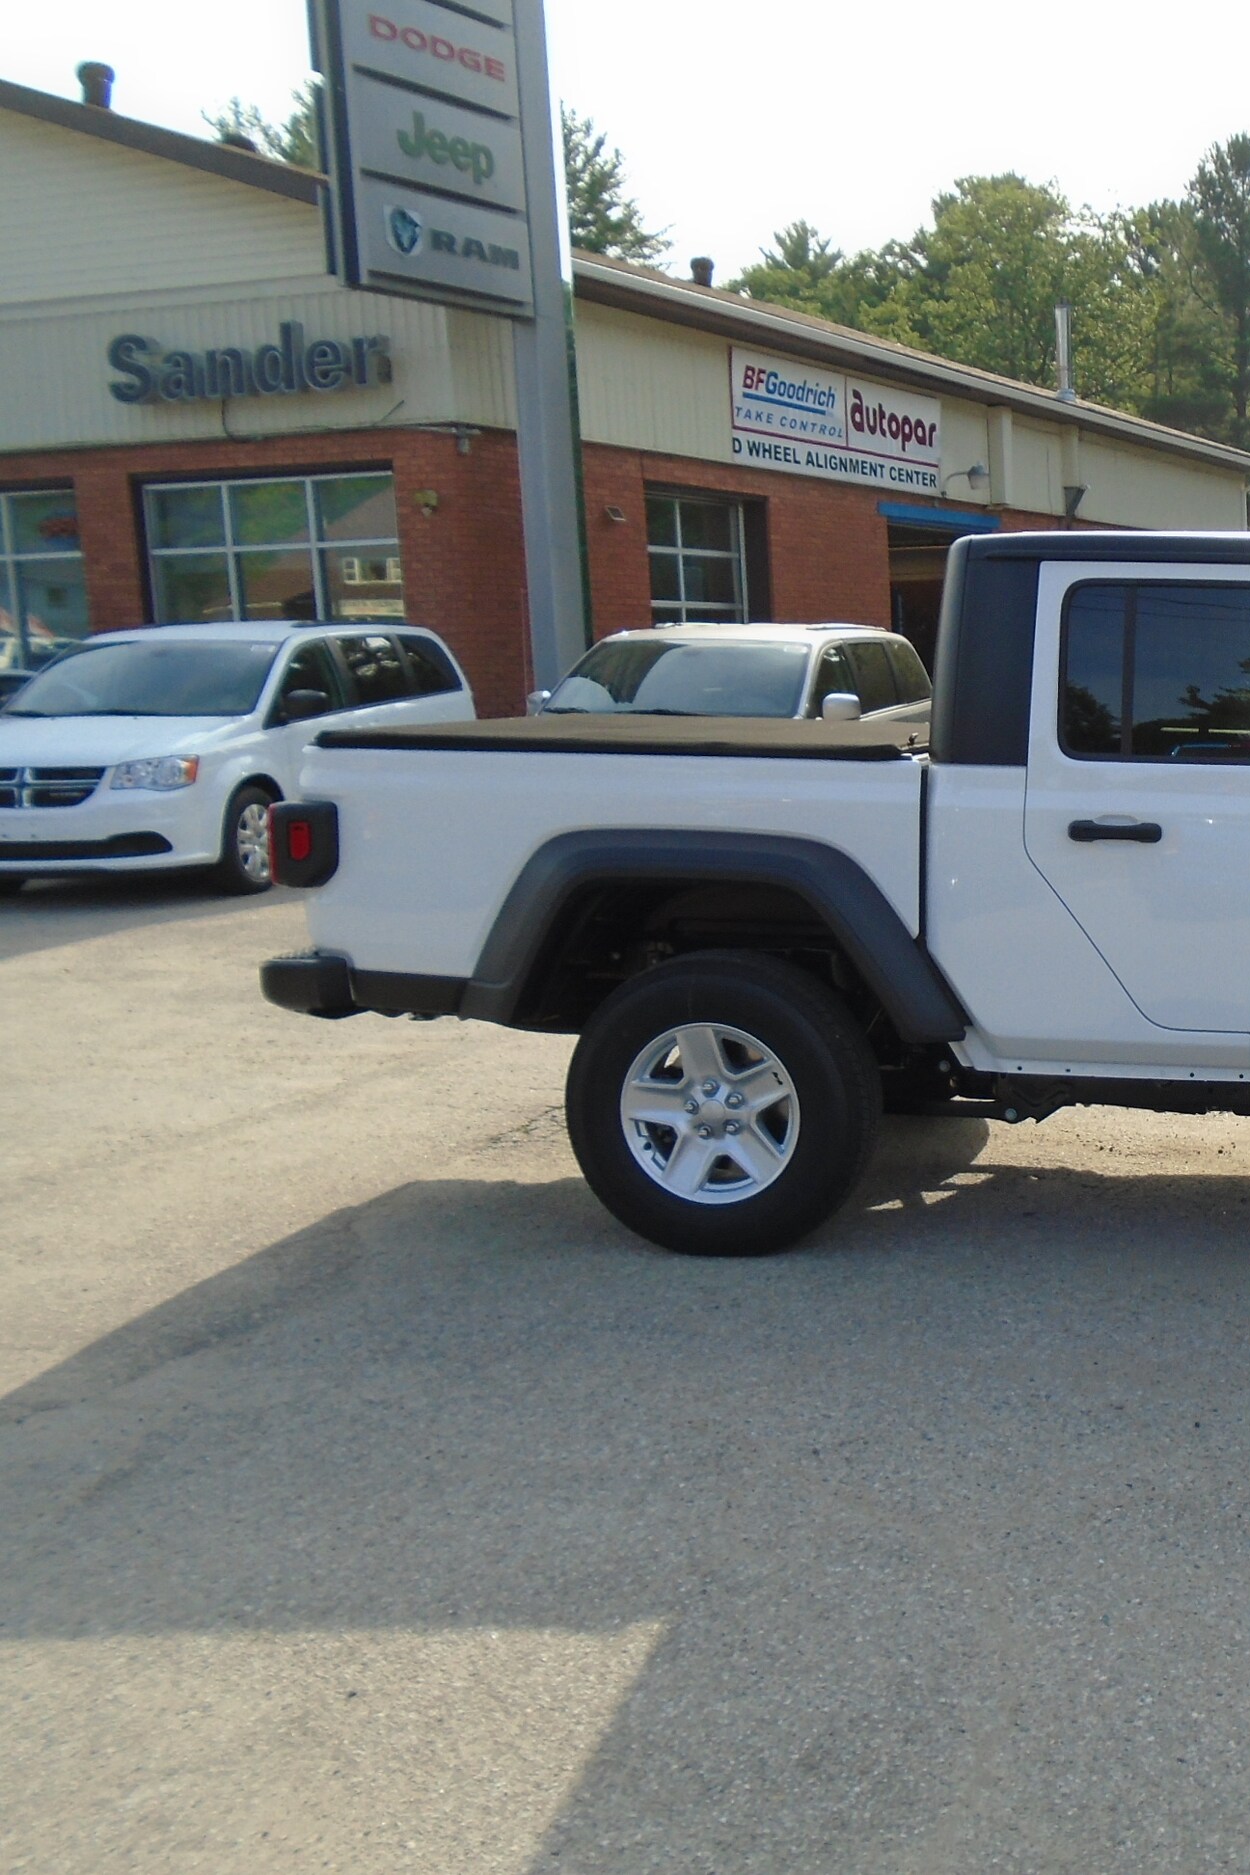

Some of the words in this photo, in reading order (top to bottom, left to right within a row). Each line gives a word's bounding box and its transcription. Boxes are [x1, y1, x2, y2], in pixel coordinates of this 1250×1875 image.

[369, 14, 505, 82] DODGE
[396, 110, 494, 184] Jeep
[430, 228, 519, 270] RAM
[107, 319, 391, 402] Sander
[742, 365, 836, 409] BFGoodrich
[735, 405, 773, 424] TAKE
[780, 416, 843, 438] CONTROL
[850, 388, 937, 451] autopar
[747, 440, 801, 465] WHEEL
[805, 451, 885, 480] ALIGNMENT
[889, 466, 937, 489] CENTER
